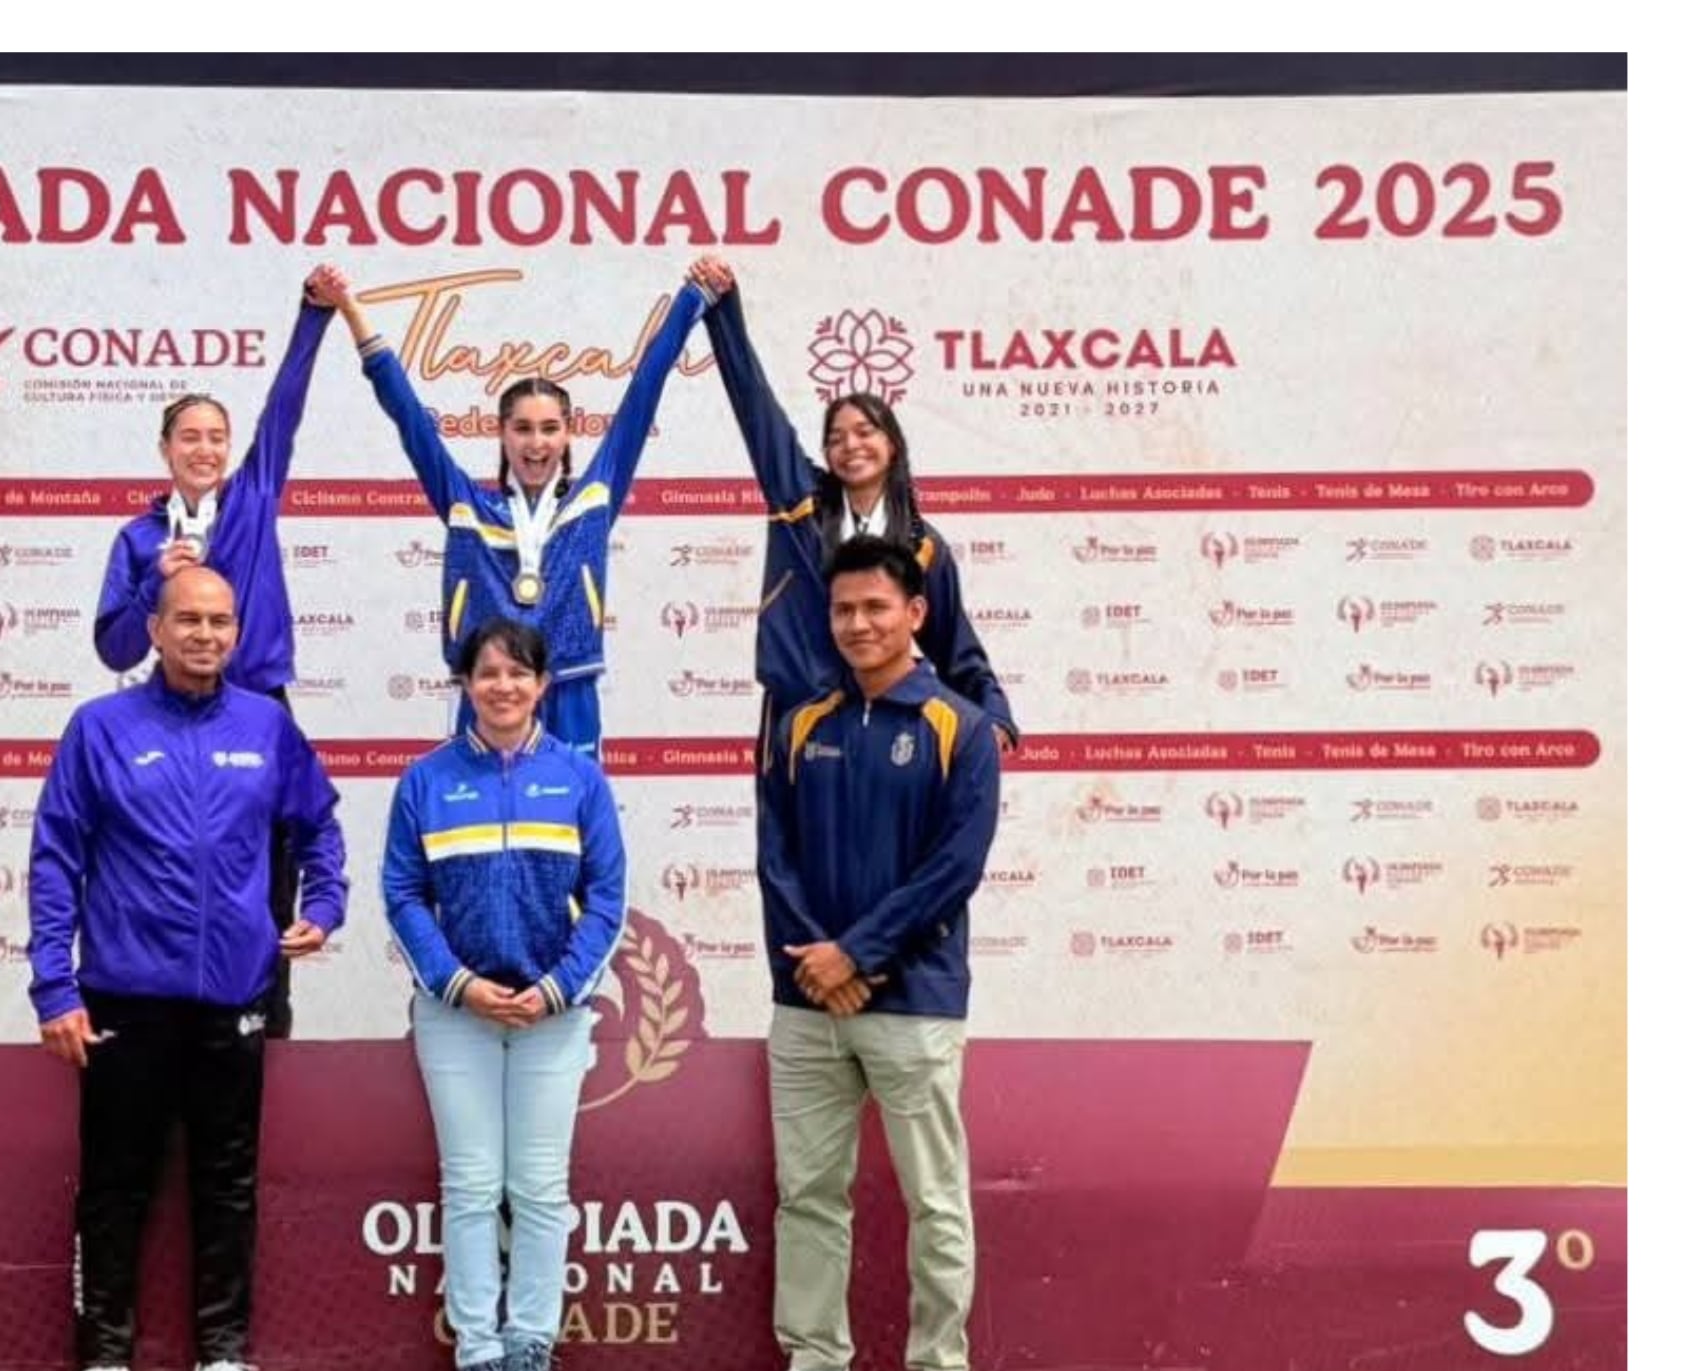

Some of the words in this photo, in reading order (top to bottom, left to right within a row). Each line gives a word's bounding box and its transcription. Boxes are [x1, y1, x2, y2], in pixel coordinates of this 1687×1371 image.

[227, 168, 781, 245] NACIONAL
[821, 166, 1269, 245] CONADE
[1314, 162, 1562, 240] 2025
[356, 269, 716, 396] Tlaxcal
[23, 328, 267, 368] CONADE
[934, 328, 1237, 371] TLAXCALA
[96, 380, 163, 390] NACIONAL
[963, 382, 1008, 396] UNA
[1021, 381, 1094, 396] NUEVA
[1107, 380, 1220, 395] HISTORIA
[1020, 403, 1071, 416] 2021
[1105, 402, 1160, 416] 2027
[661, 489, 735, 504] Gimnasia
[1016, 487, 1055, 502] Judo
[1080, 487, 1137, 501] Luchas
[1143, 486, 1223, 500] Asociadas
[1249, 485, 1291, 499] Tenis
[1315, 484, 1359, 498] Tenis
[1364, 484, 1384, 498] de
[1388, 484, 1431, 498] Mesa
[1456, 483, 1488, 497] Tiro
[1493, 485, 1524, 497] con
[1529, 483, 1569, 496] Arco
[5, 490, 24, 505] de
[31, 491, 101, 505] Montaña
[292, 491, 361, 505] Ciclismo
[296, 615, 354, 626] AXCALA
[970, 609, 1031, 620] LAXCALA
[663, 750, 739, 764] Gimnasia
[1020, 747, 1059, 760] Judo
[1085, 746, 1141, 760] Luchas
[1147, 745, 1228, 759] Asociadas
[1253, 744, 1296, 758] Tenis
[1322, 744, 1364, 758] Tenis
[1369, 743, 1388, 757] de
[1393, 744, 1437, 757] Mesa
[1463, 743, 1495, 757] Tiro
[1501, 745, 1530, 756] con
[1535, 743, 1575, 756] Arco
[3, 752, 22, 767] de
[981, 871, 1035, 882] AXCALA
[362, 1200, 749, 1256] OLIADA
